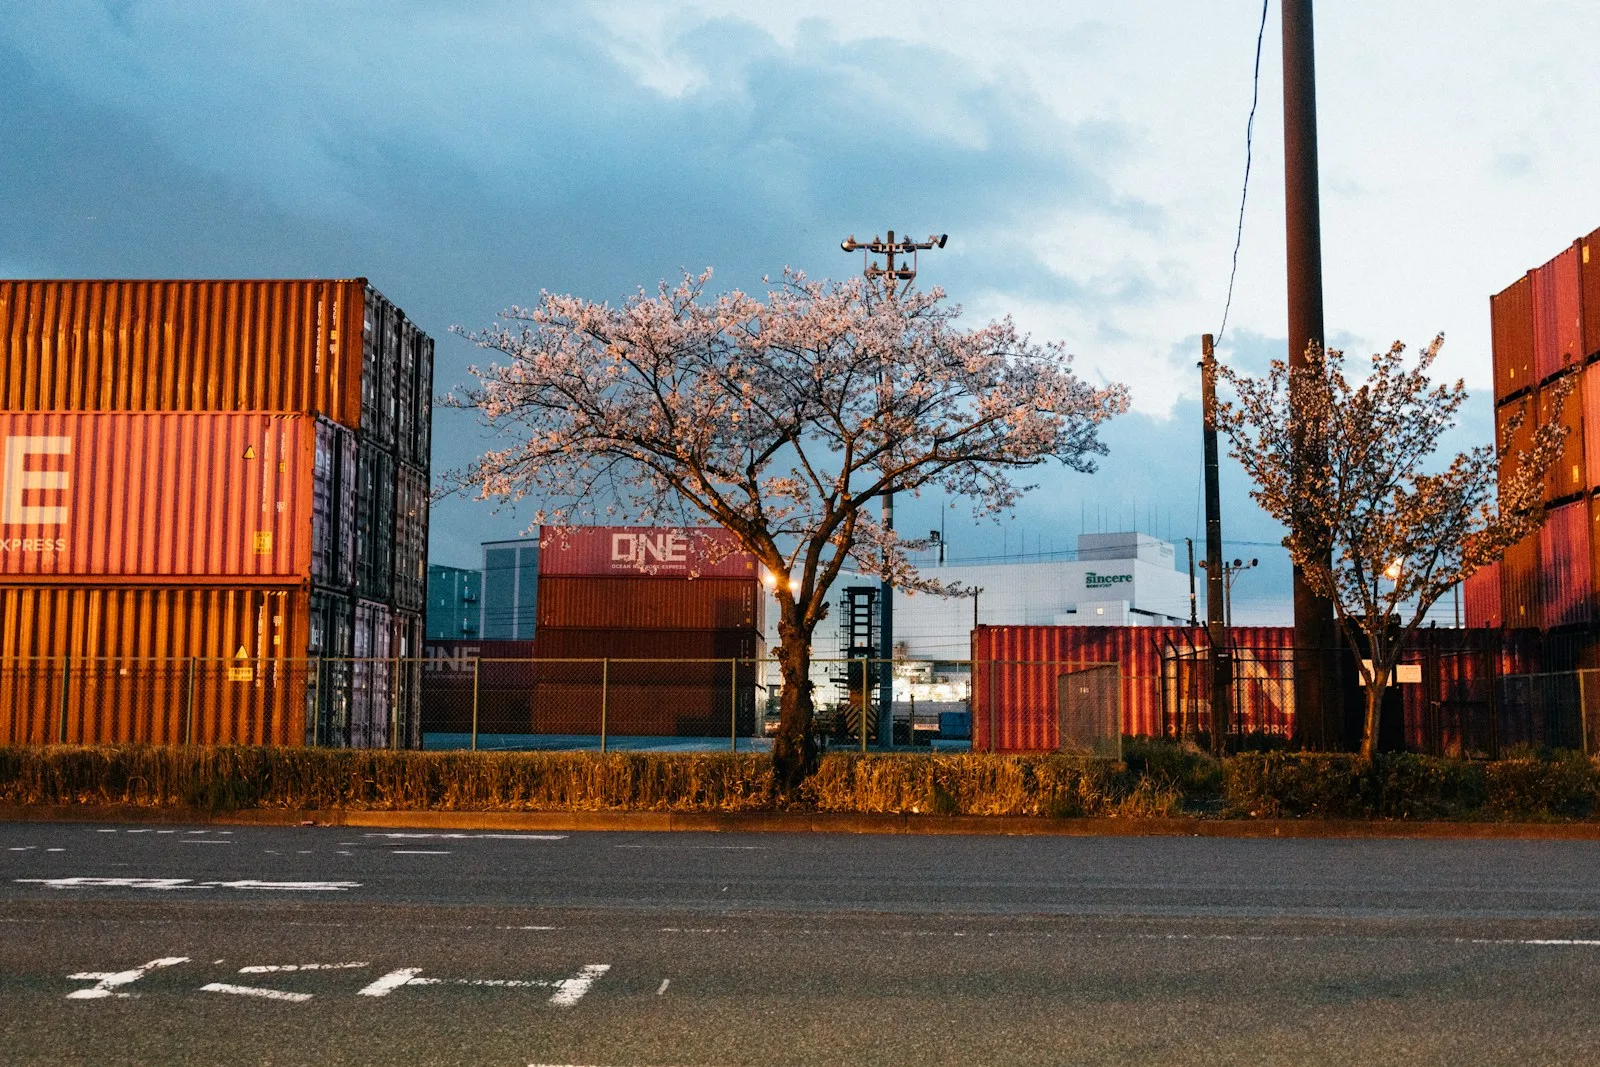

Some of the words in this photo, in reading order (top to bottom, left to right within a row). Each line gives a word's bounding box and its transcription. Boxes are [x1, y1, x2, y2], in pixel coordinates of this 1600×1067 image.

[2, 436, 71, 524] E
[611, 533, 687, 561] ONE
[1086, 572, 1133, 584] sincere
